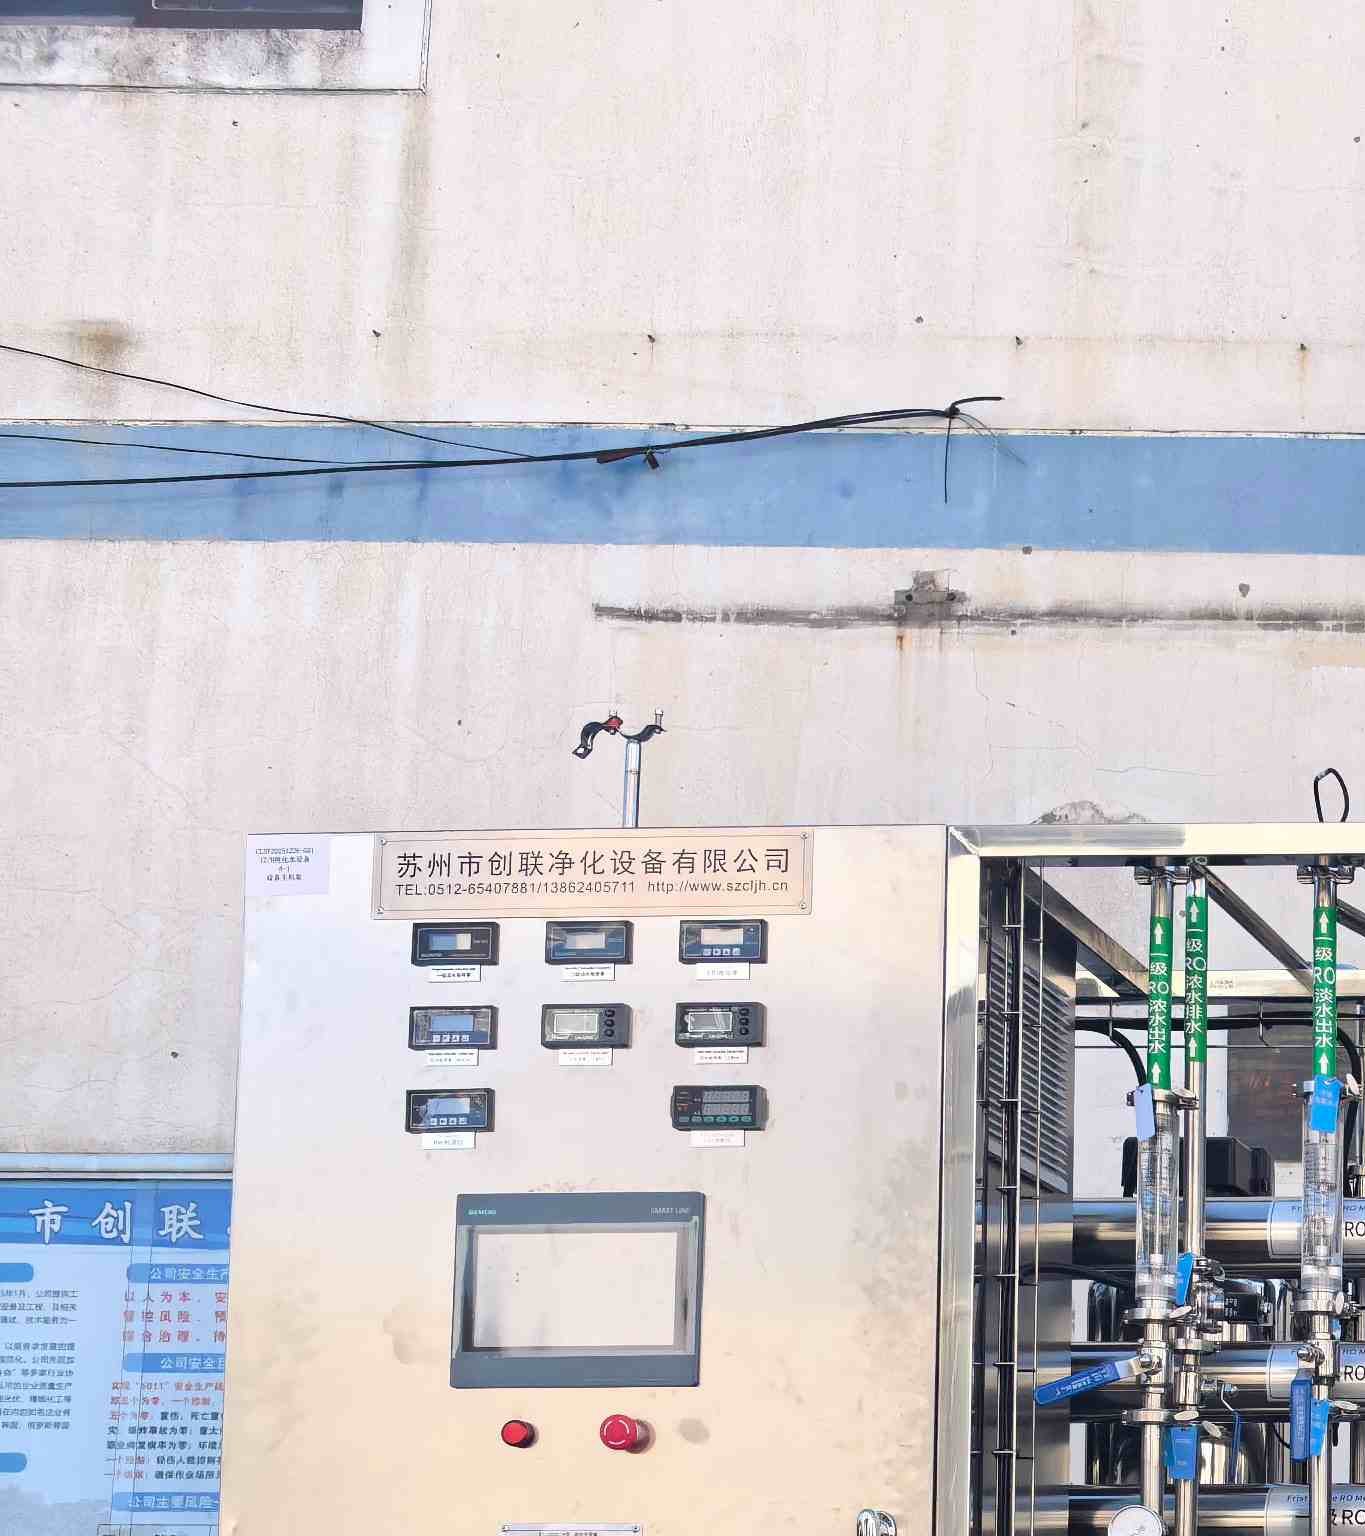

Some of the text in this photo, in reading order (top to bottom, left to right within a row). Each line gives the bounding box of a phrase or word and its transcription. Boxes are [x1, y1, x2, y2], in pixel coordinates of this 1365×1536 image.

[397, 848, 791, 879] 苏州市创联净化设备有限公司
[395, 881, 637, 897] TEL:0512-65407881/13862405711
[1313, 937, 1336, 1048] 一级RO淡水出水
[28, 1199, 231, 1244] 市创联
